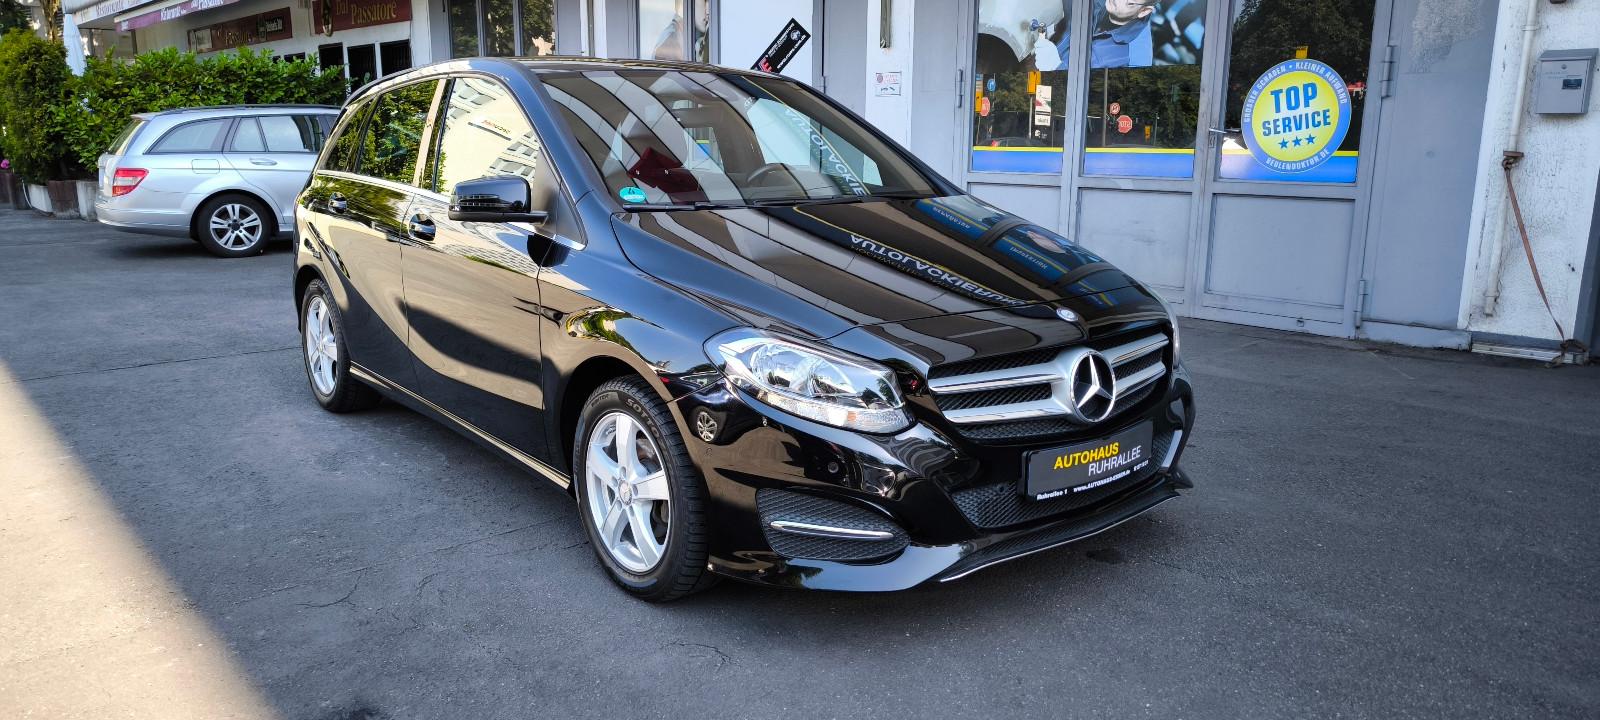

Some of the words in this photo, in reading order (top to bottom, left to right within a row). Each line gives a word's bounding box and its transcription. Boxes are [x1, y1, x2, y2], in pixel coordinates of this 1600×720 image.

[351, 1, 398, 25] Passatore
[1257, 65, 1287, 90] SCHADEN
[1295, 62, 1325, 76] KLEINER
[1324, 71, 1348, 105] AUFWAND
[1270, 82, 1318, 114] TOP
[1262, 108, 1332, 137] SERVICE
[1266, 149, 1330, 171] BEULENDOKTOR.DE
[1053, 442, 1119, 470] AUTOHAUS
[1088, 445, 1142, 476] RUHRALLEE
[1036, 490, 1064, 500] Ruhrallee
